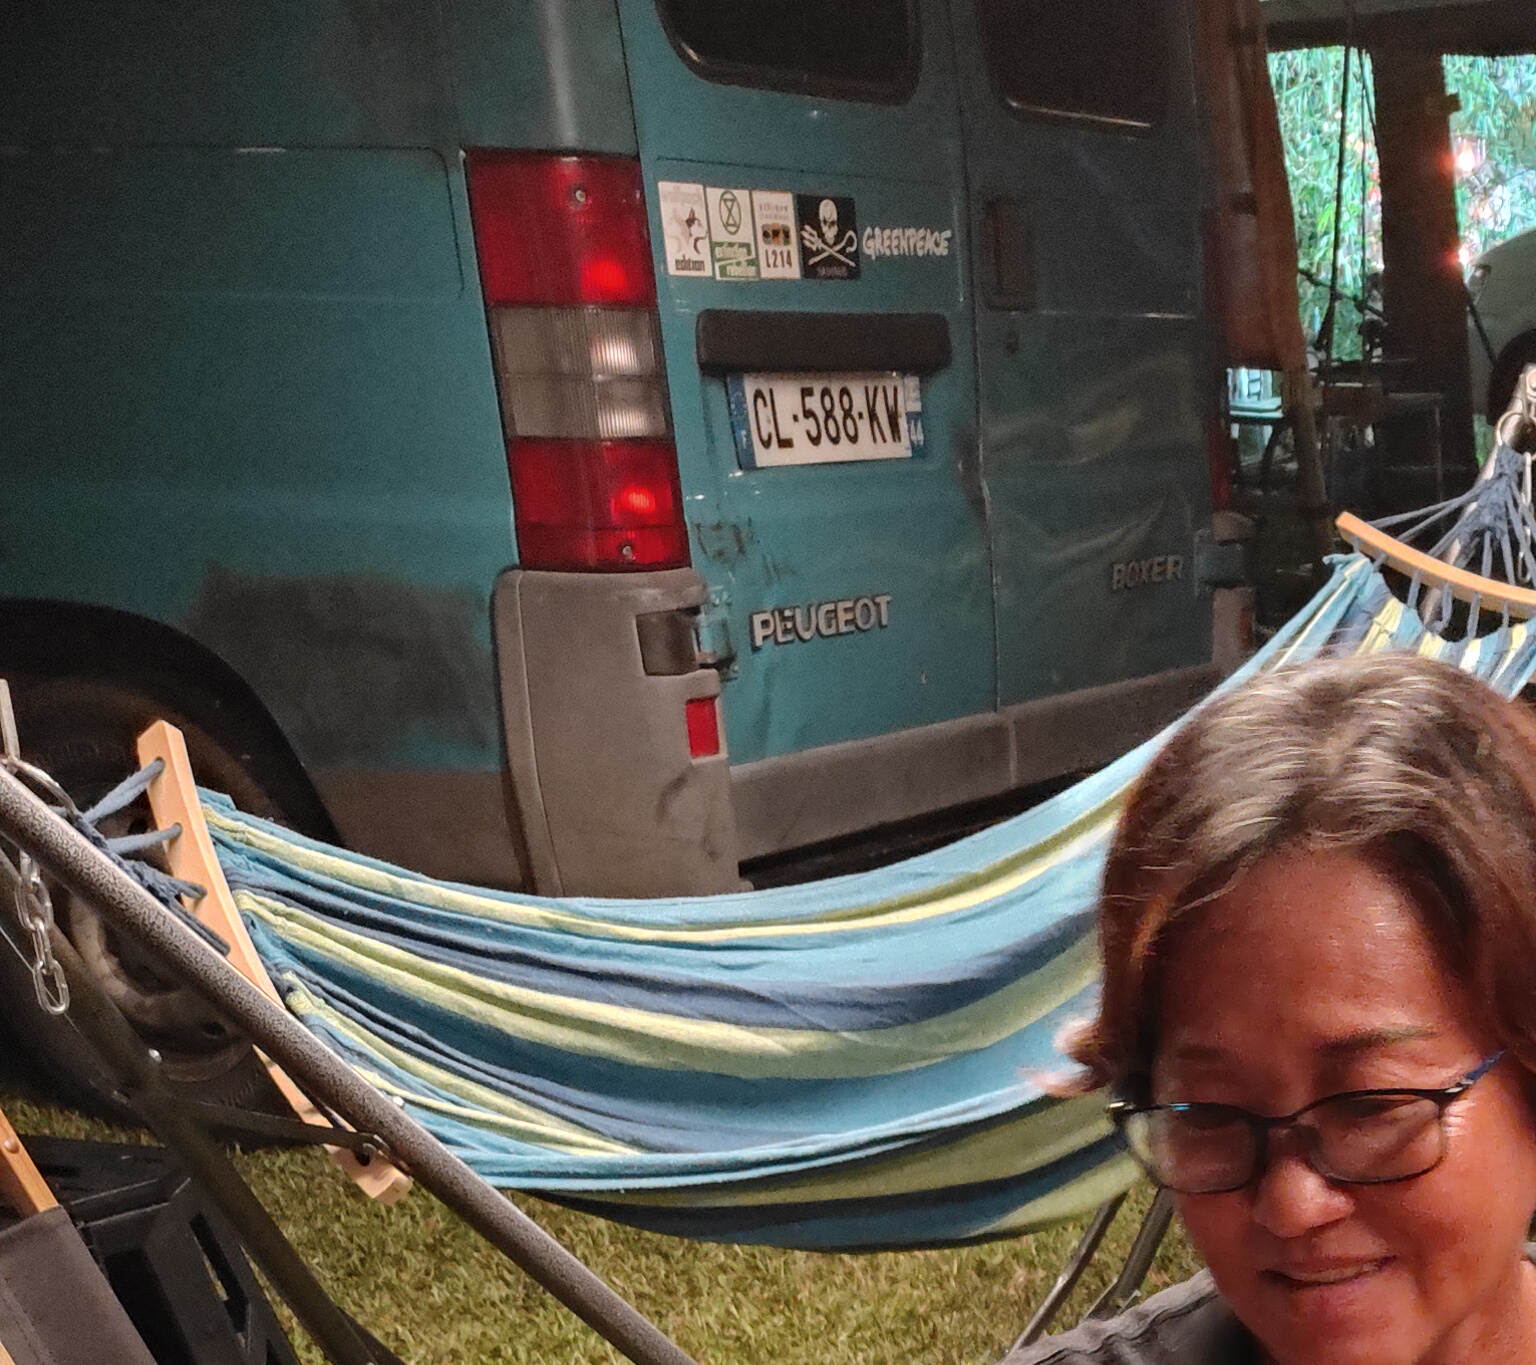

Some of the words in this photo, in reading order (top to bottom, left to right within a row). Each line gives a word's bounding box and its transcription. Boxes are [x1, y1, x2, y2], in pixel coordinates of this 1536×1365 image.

[765, 248, 793, 269] L214
[862, 226, 952, 260] GREENPEACE
[1111, 554, 1184, 591] BOXER
[750, 594, 892, 651] PEUGEOT
